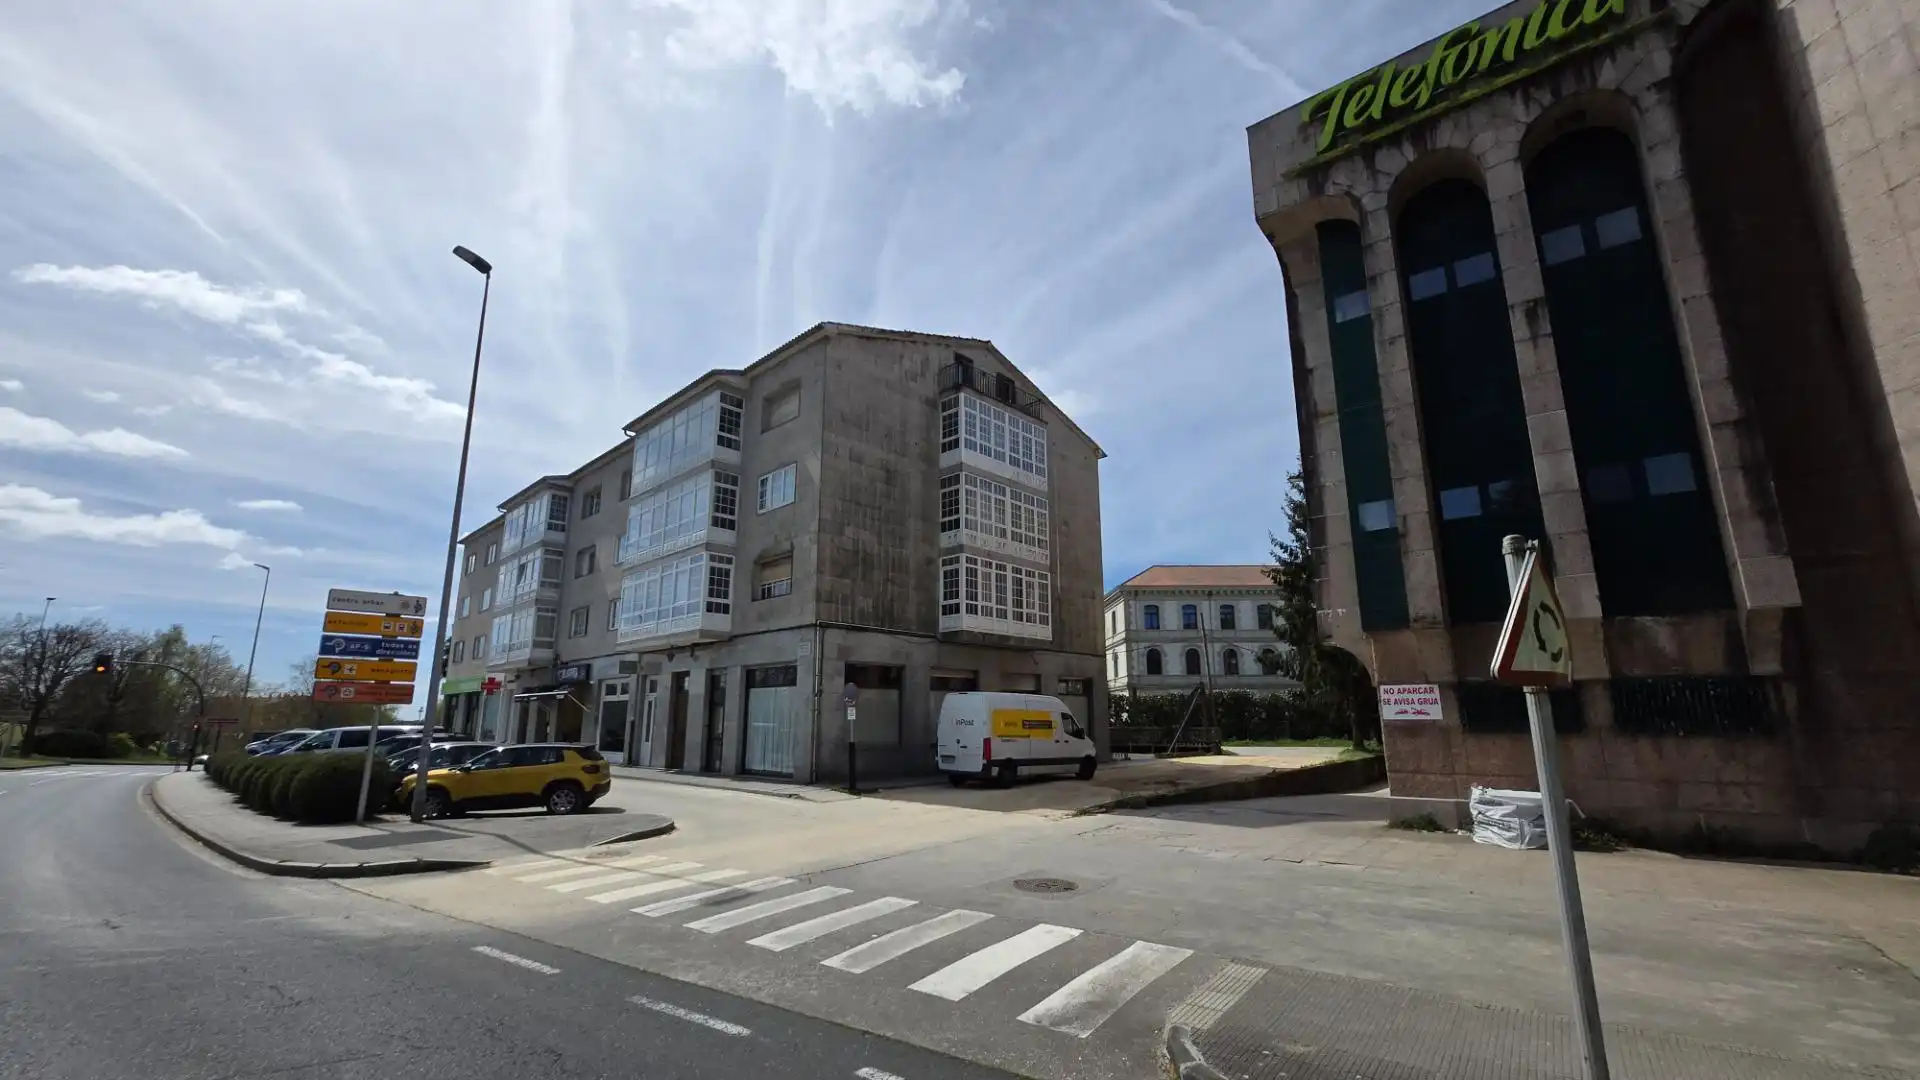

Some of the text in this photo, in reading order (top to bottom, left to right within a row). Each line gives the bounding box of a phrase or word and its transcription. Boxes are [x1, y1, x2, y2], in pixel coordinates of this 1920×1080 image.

[1382, 697, 1439, 706] SE AVISA GRUA
